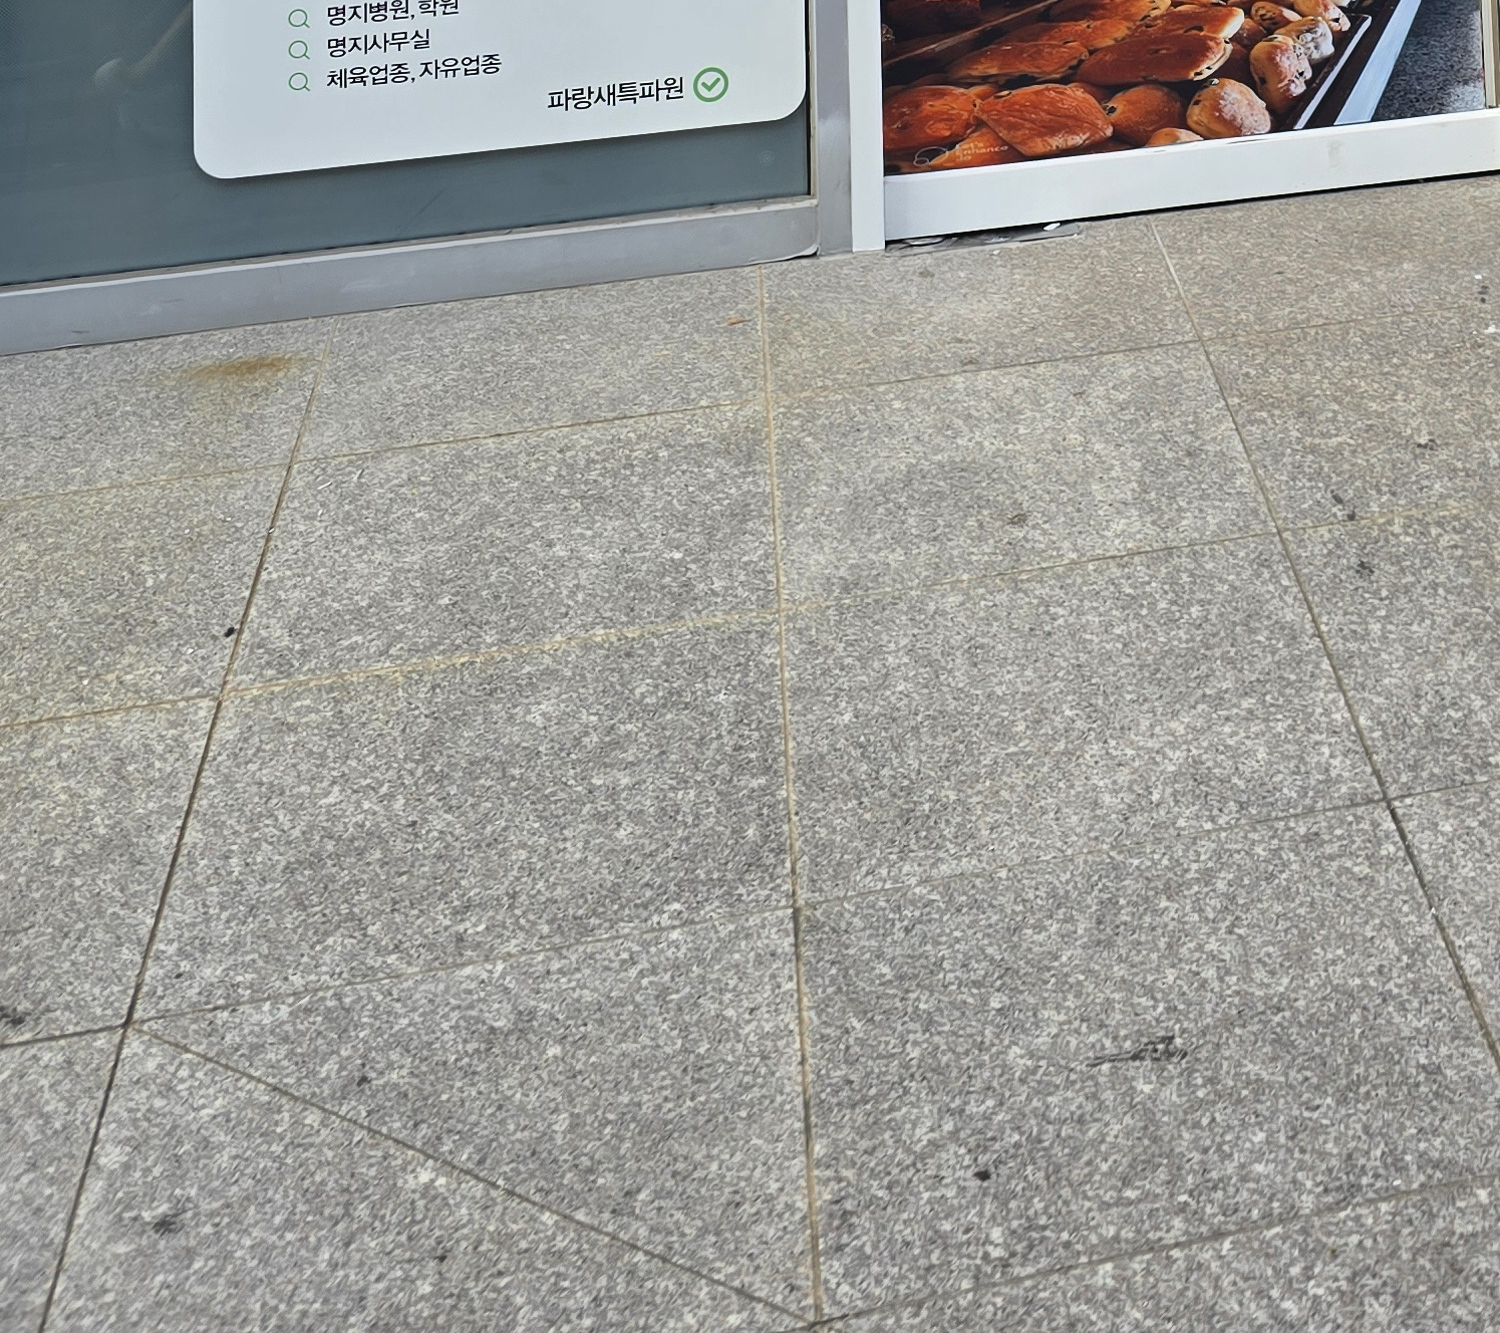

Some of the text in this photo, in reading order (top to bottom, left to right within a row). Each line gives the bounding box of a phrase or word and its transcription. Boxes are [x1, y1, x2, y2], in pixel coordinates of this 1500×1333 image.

[326, 27, 431, 59] 명지사무실
[419, 52, 502, 83] 자유업종
[548, 75, 685, 113] 파랑새특파원
